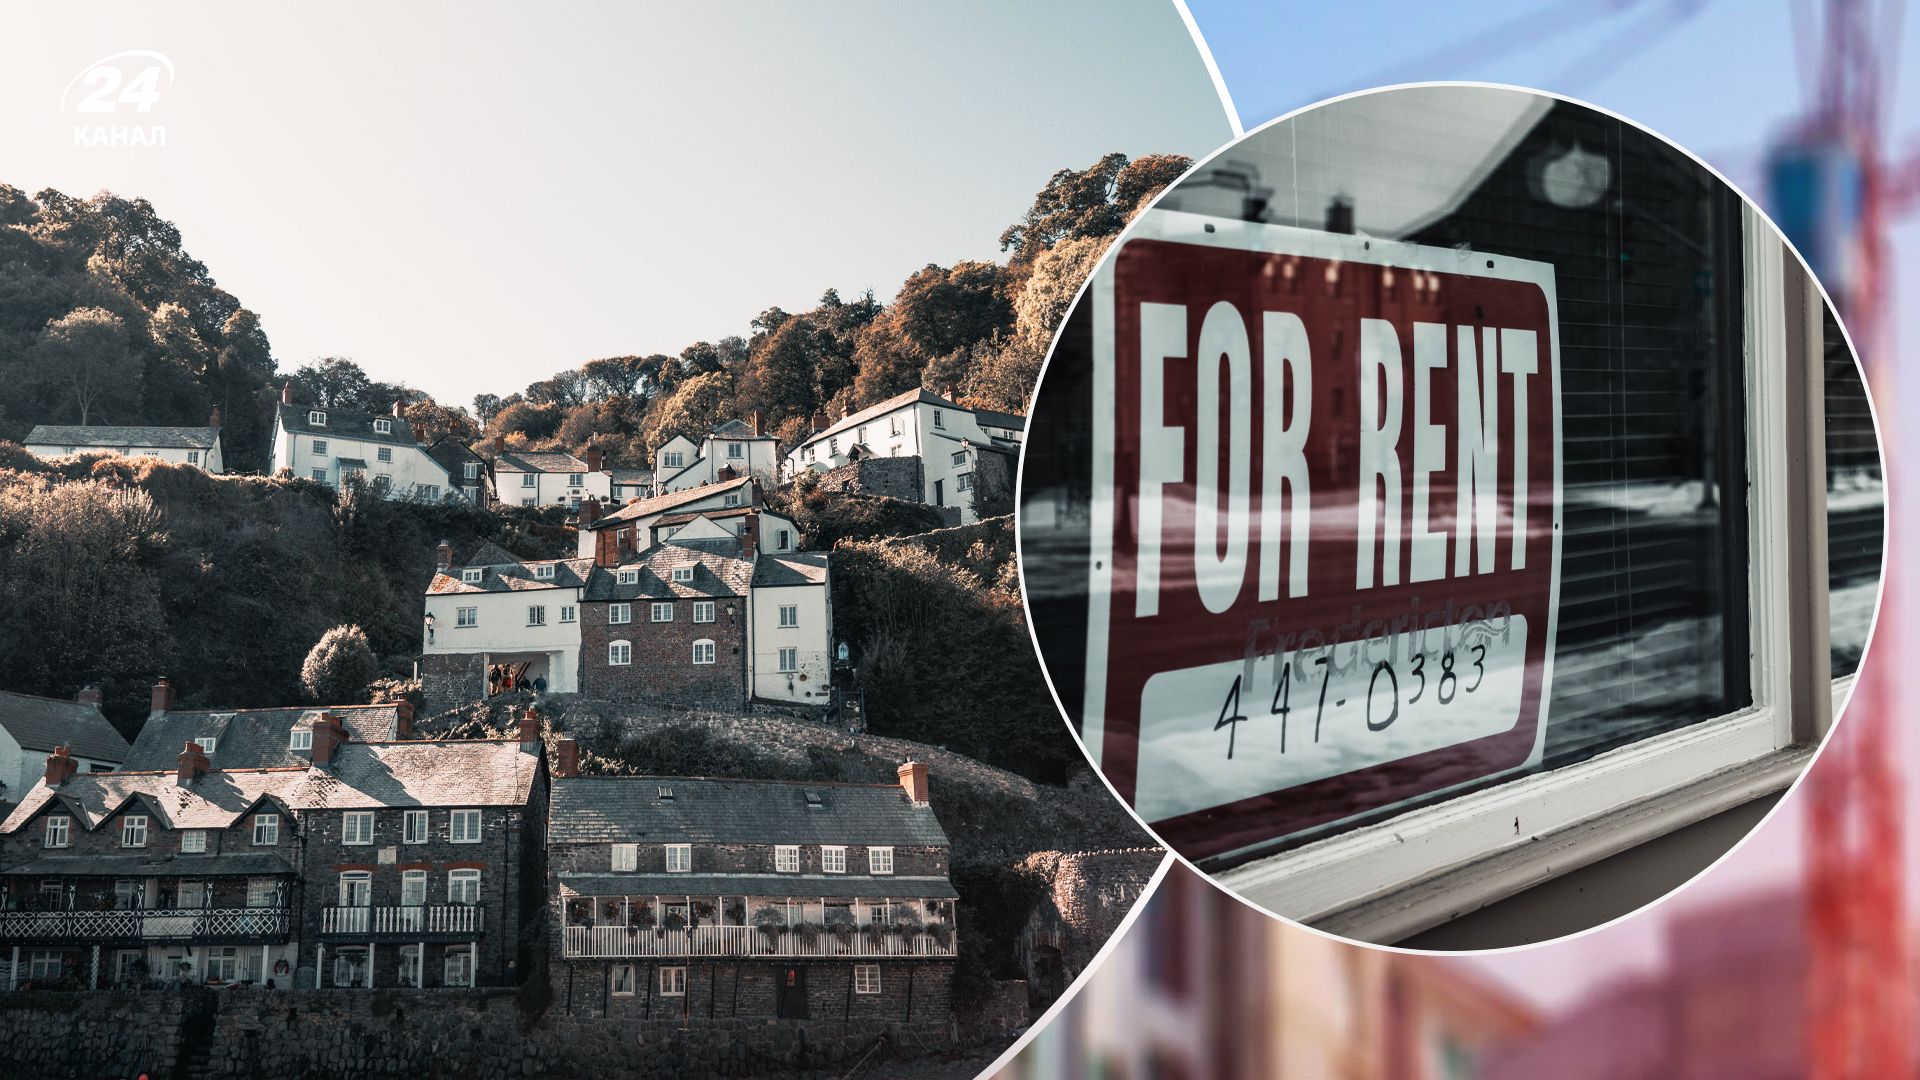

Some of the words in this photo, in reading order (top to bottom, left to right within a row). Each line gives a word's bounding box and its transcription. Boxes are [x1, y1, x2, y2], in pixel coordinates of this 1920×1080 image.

[1135, 300, 1312, 618] FOR
[1356, 317, 1539, 590] RENT
[1213, 644, 1486, 759] 447-0383
